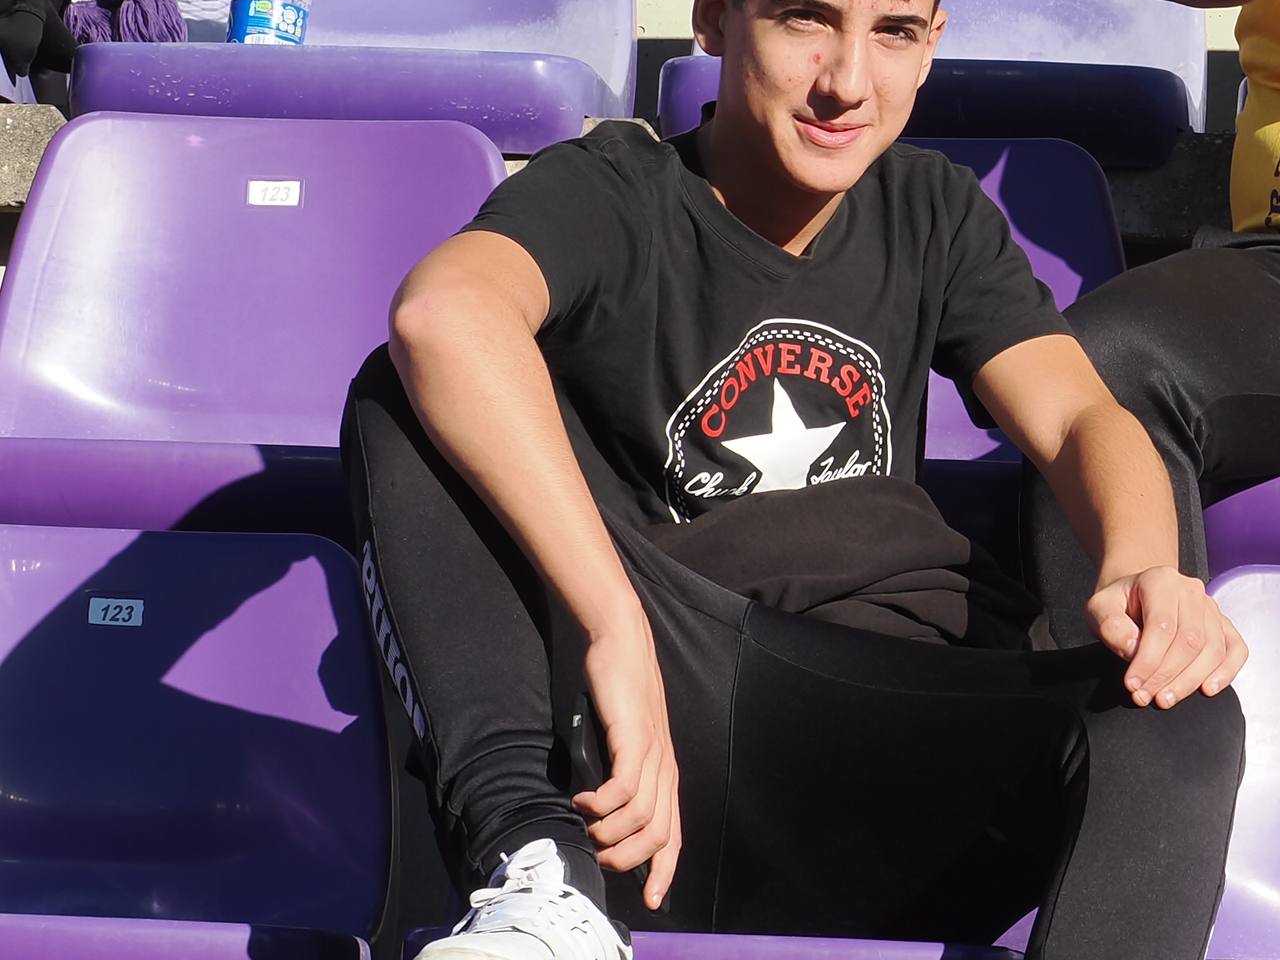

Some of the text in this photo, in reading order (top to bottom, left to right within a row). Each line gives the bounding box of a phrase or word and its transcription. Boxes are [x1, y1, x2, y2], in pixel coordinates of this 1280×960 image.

[260, 185, 292, 202] 123
[701, 342, 874, 438] CONVERSE
[100, 604, 135, 622] 123
